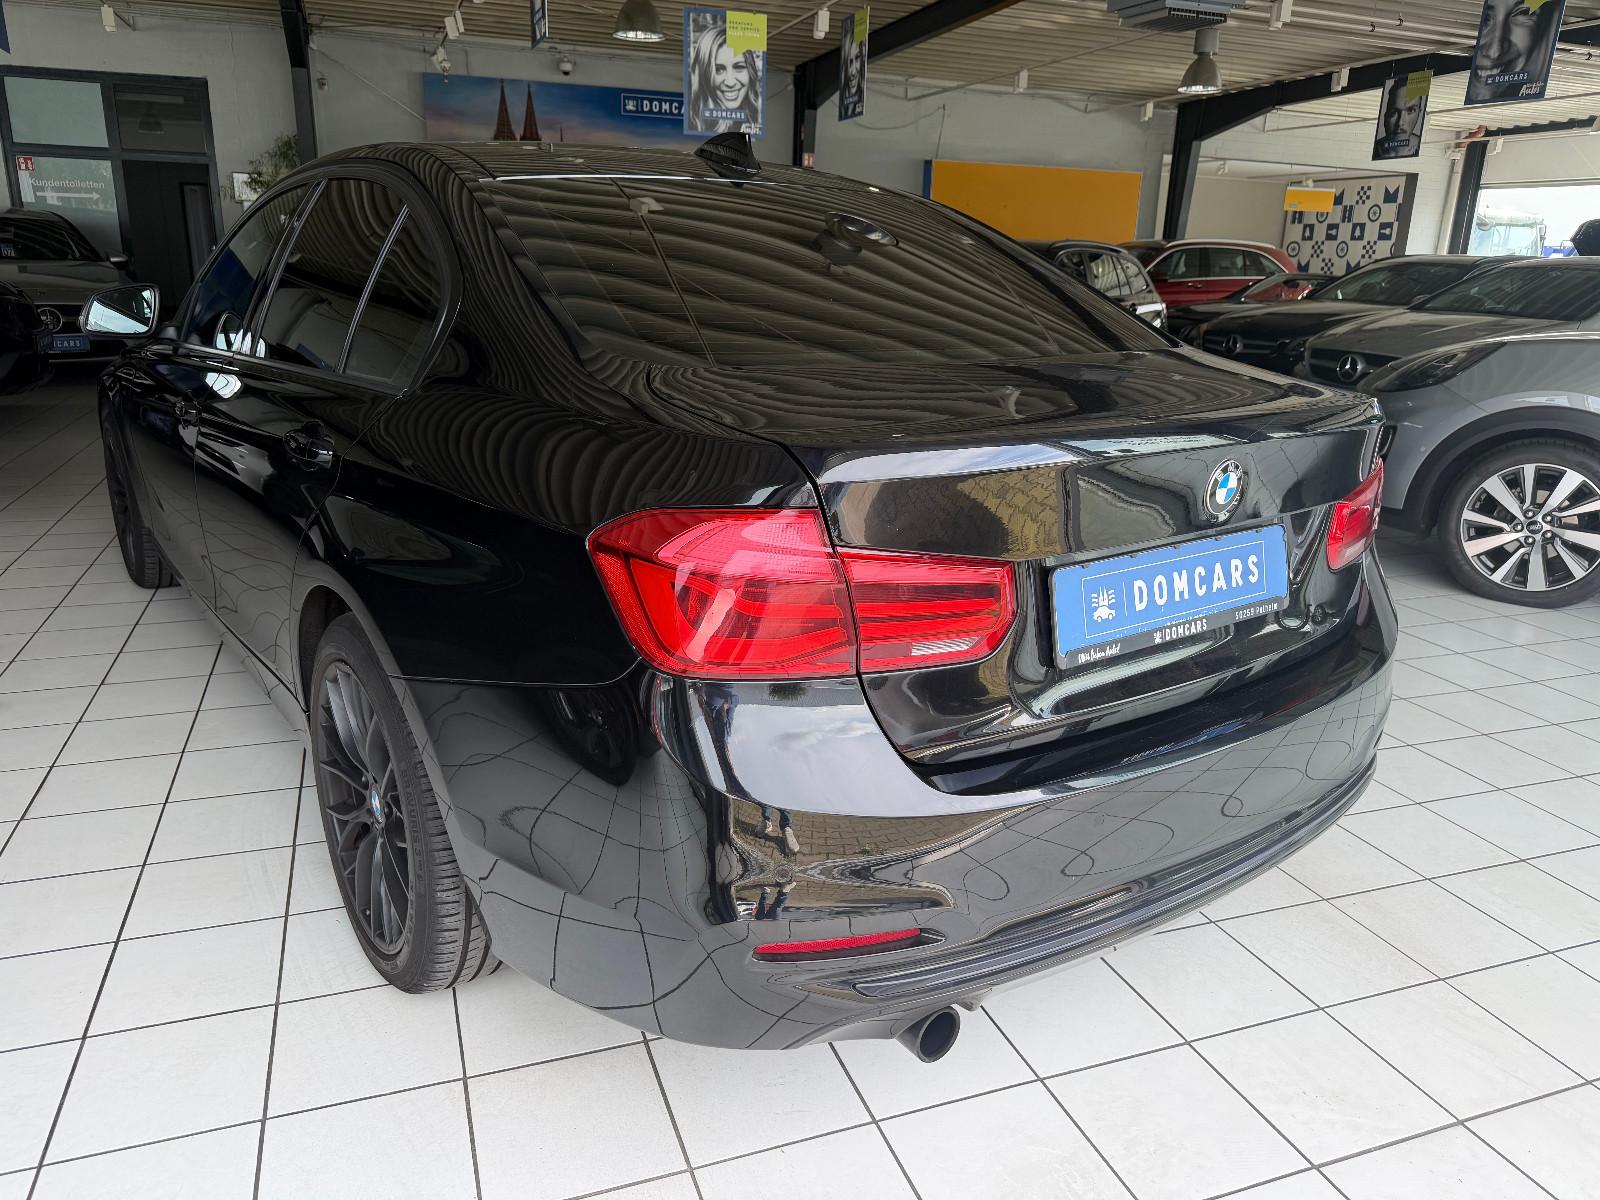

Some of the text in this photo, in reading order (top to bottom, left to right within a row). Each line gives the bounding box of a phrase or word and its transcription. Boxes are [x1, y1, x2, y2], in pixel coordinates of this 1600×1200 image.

[643, 100, 684, 114] DOMC
[713, 110, 745, 119] DOMCARS
[31, 178, 105, 189] Kundentoiletten
[1133, 554, 1259, 612] DOMCARS
[1165, 619, 1208, 641] DOMCARS
